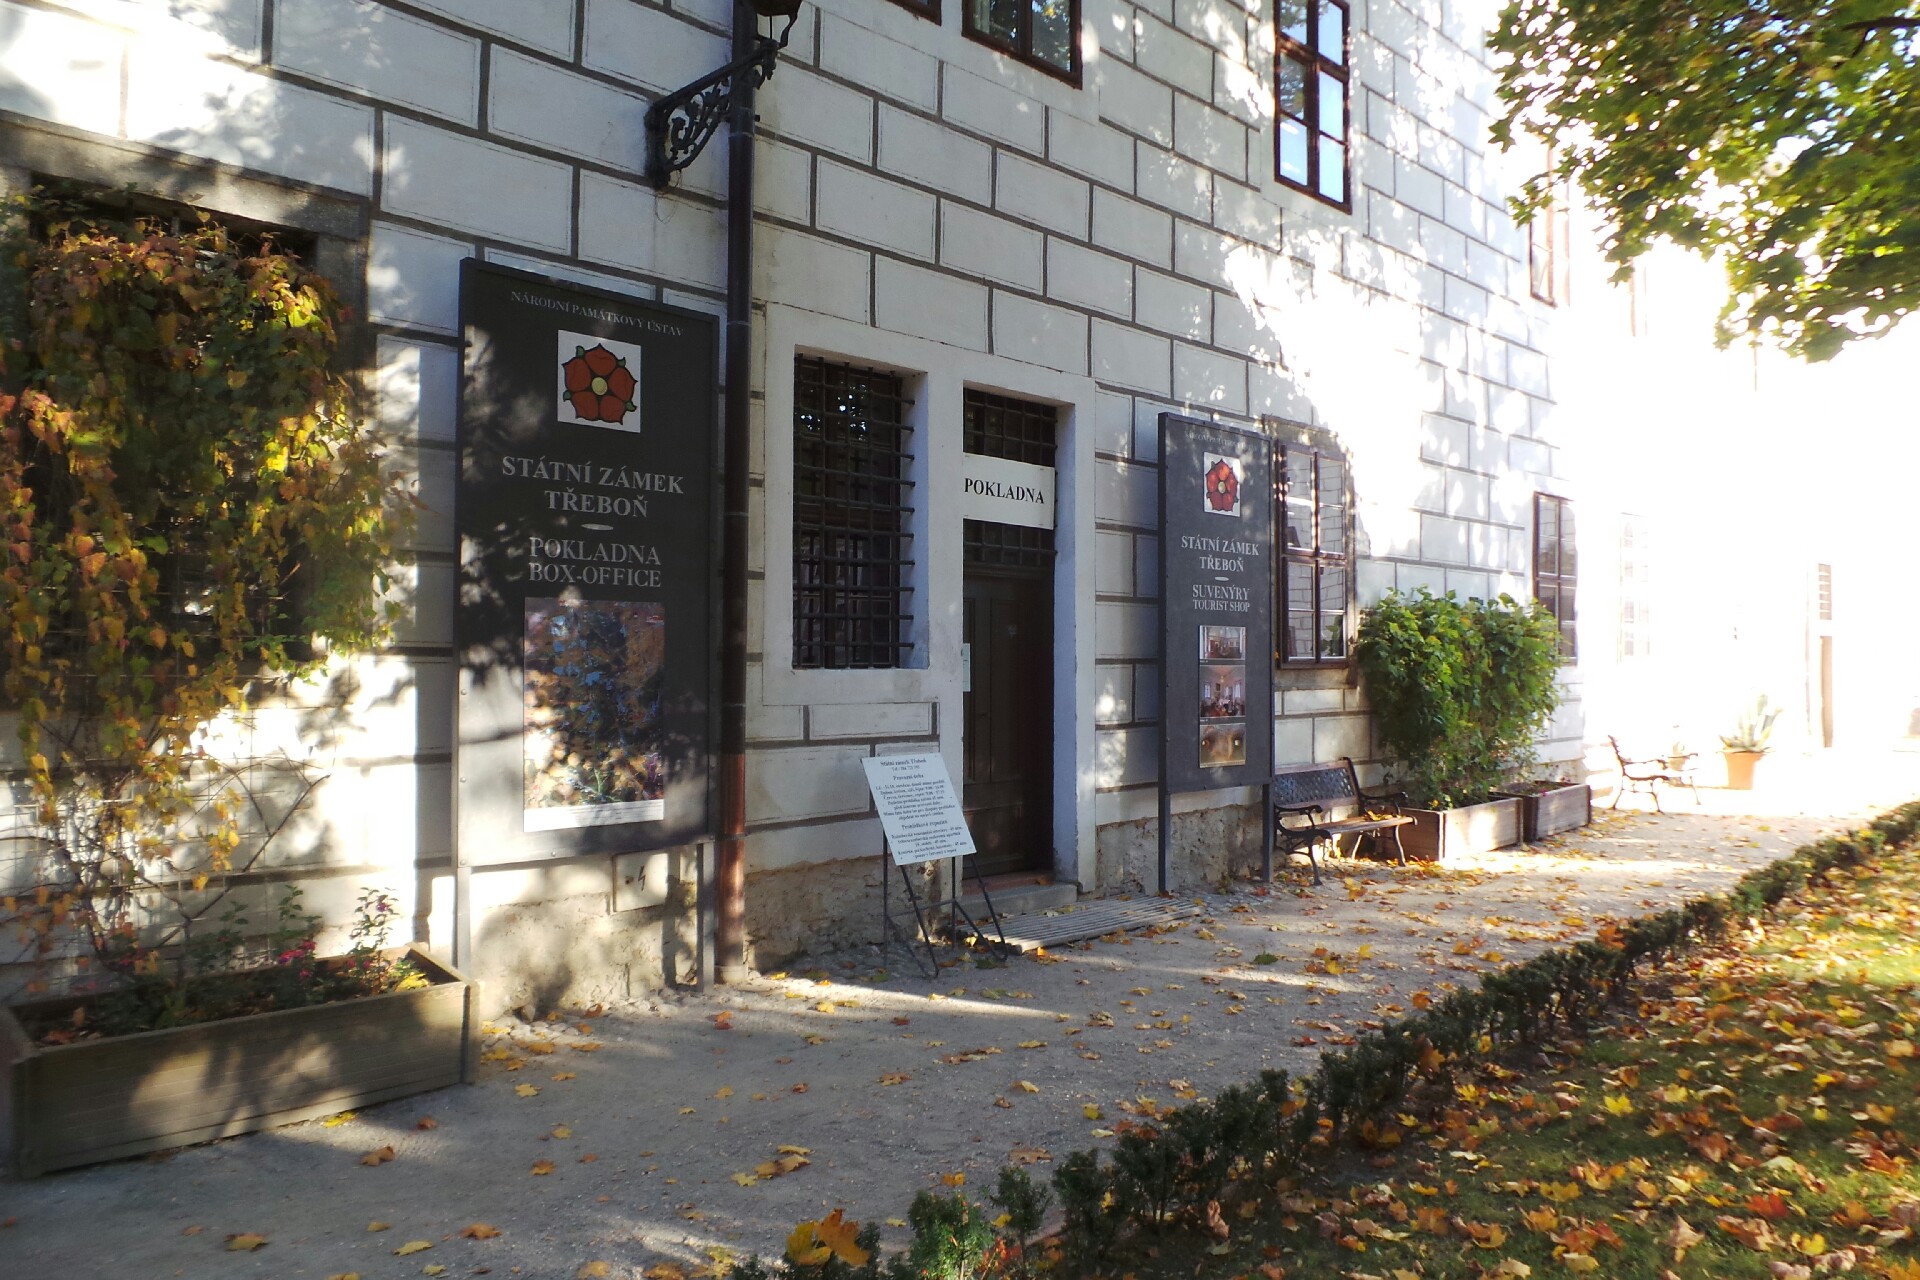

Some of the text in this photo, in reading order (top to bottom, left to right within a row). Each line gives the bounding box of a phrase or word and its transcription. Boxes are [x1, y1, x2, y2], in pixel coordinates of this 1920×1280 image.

[502, 455, 684, 494] STÁTNÍ ZÁMEK
[544, 486, 649, 518] TŘEBOŇ
[964, 477, 1045, 504] POKLADNA
[529, 536, 662, 566] POKLADNA
[1181, 534, 1259, 555] STÁTNÍ ZÁMEK
[529, 562, 662, 588] BOX-OFFICE
[1200, 554, 1244, 572] TŘEBOŇ
[1192, 584, 1250, 601] SUVENÝRY
[1193, 599, 1250, 612] TOURIST SHOP
